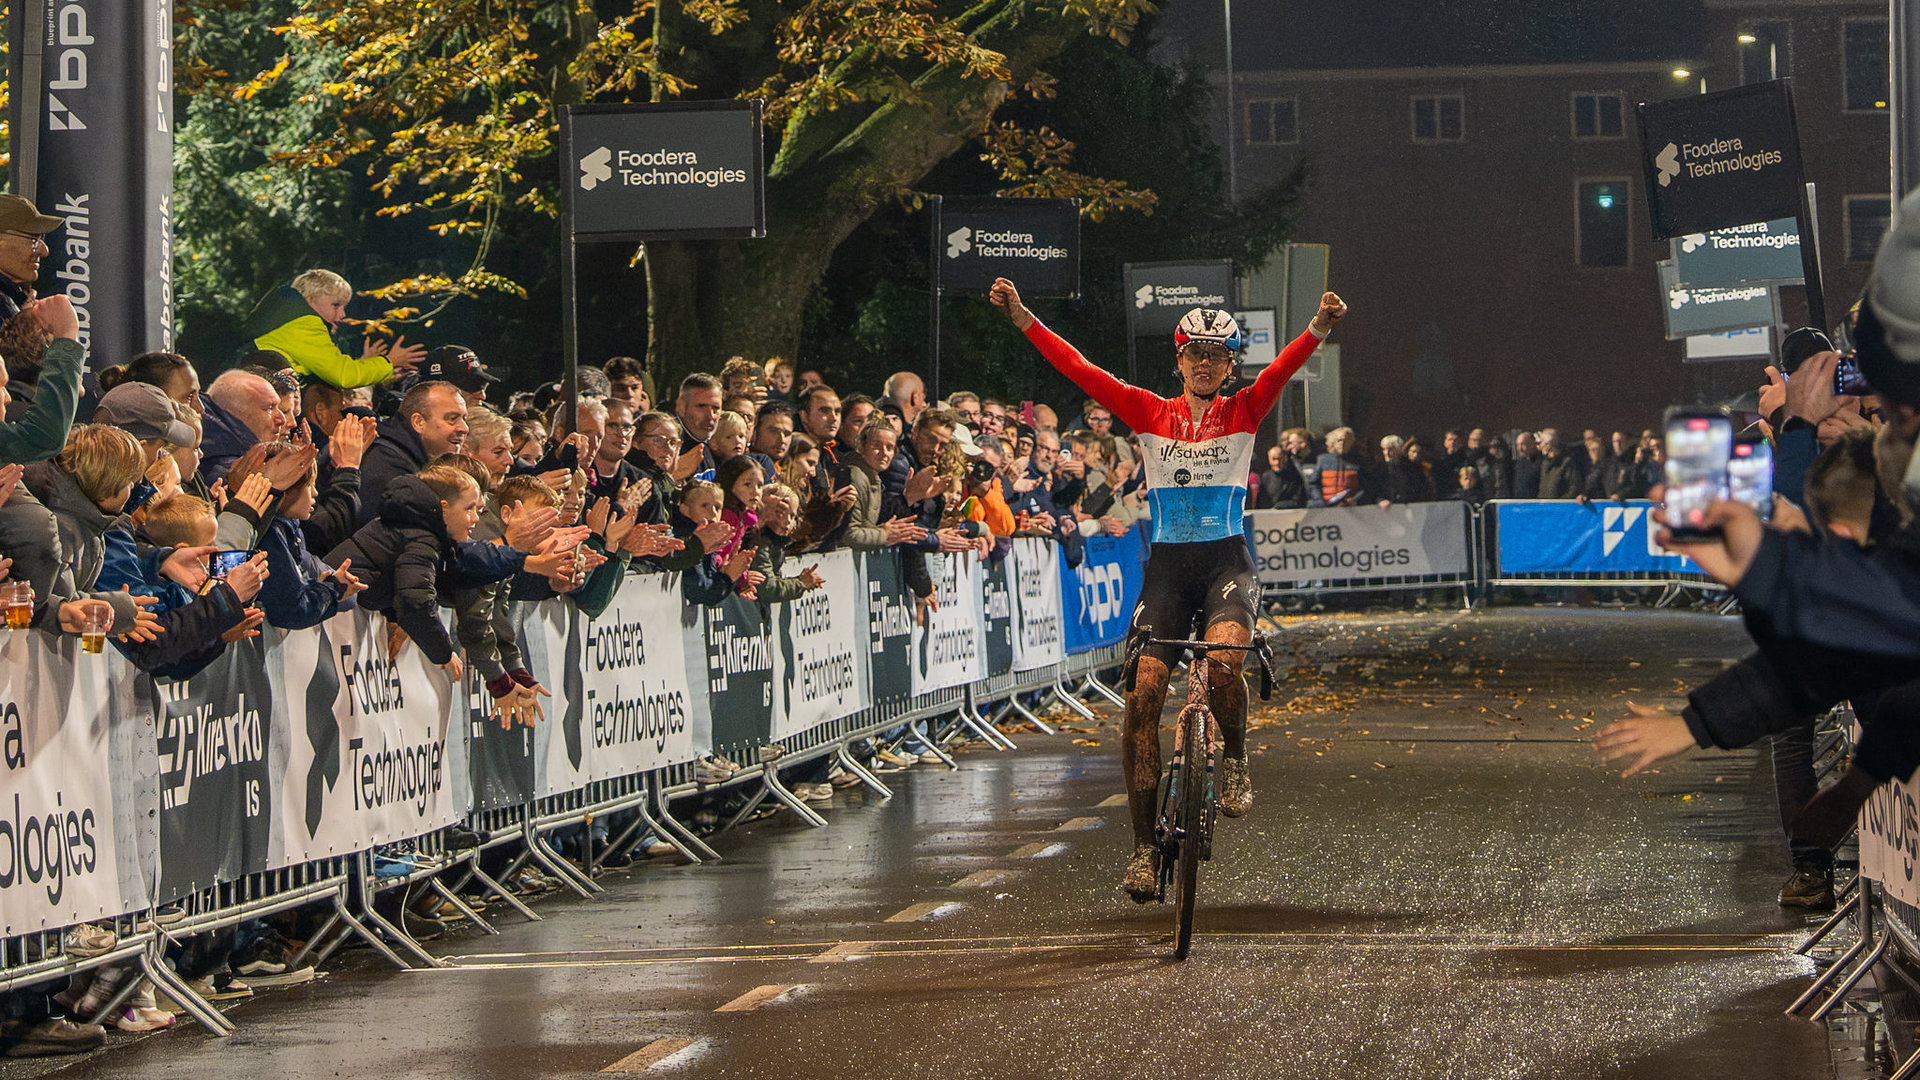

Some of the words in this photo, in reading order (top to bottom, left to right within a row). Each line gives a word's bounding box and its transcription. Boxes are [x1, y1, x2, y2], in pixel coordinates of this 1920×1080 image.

[47, 8, 56, 46] blueprint
[49, 0, 95, 90] bp
[618, 149, 698, 167] Foodera
[1683, 137, 1743, 160] Foodera
[1685, 149, 1783, 178] Technologies
[618, 166, 747, 188] Technologies
[975, 230, 1034, 244] Foodera
[975, 244, 1068, 261] Technologies
[159, 194, 171, 354] abobank
[1155, 285, 1199, 296] Foodera
[1692, 286, 1767, 305] Technologies
[1255, 522, 1343, 546] oodera
[1257, 545, 1410, 572] echnologies
[586, 607, 646, 672] Foodera
[587, 679, 685, 754] Technologies
